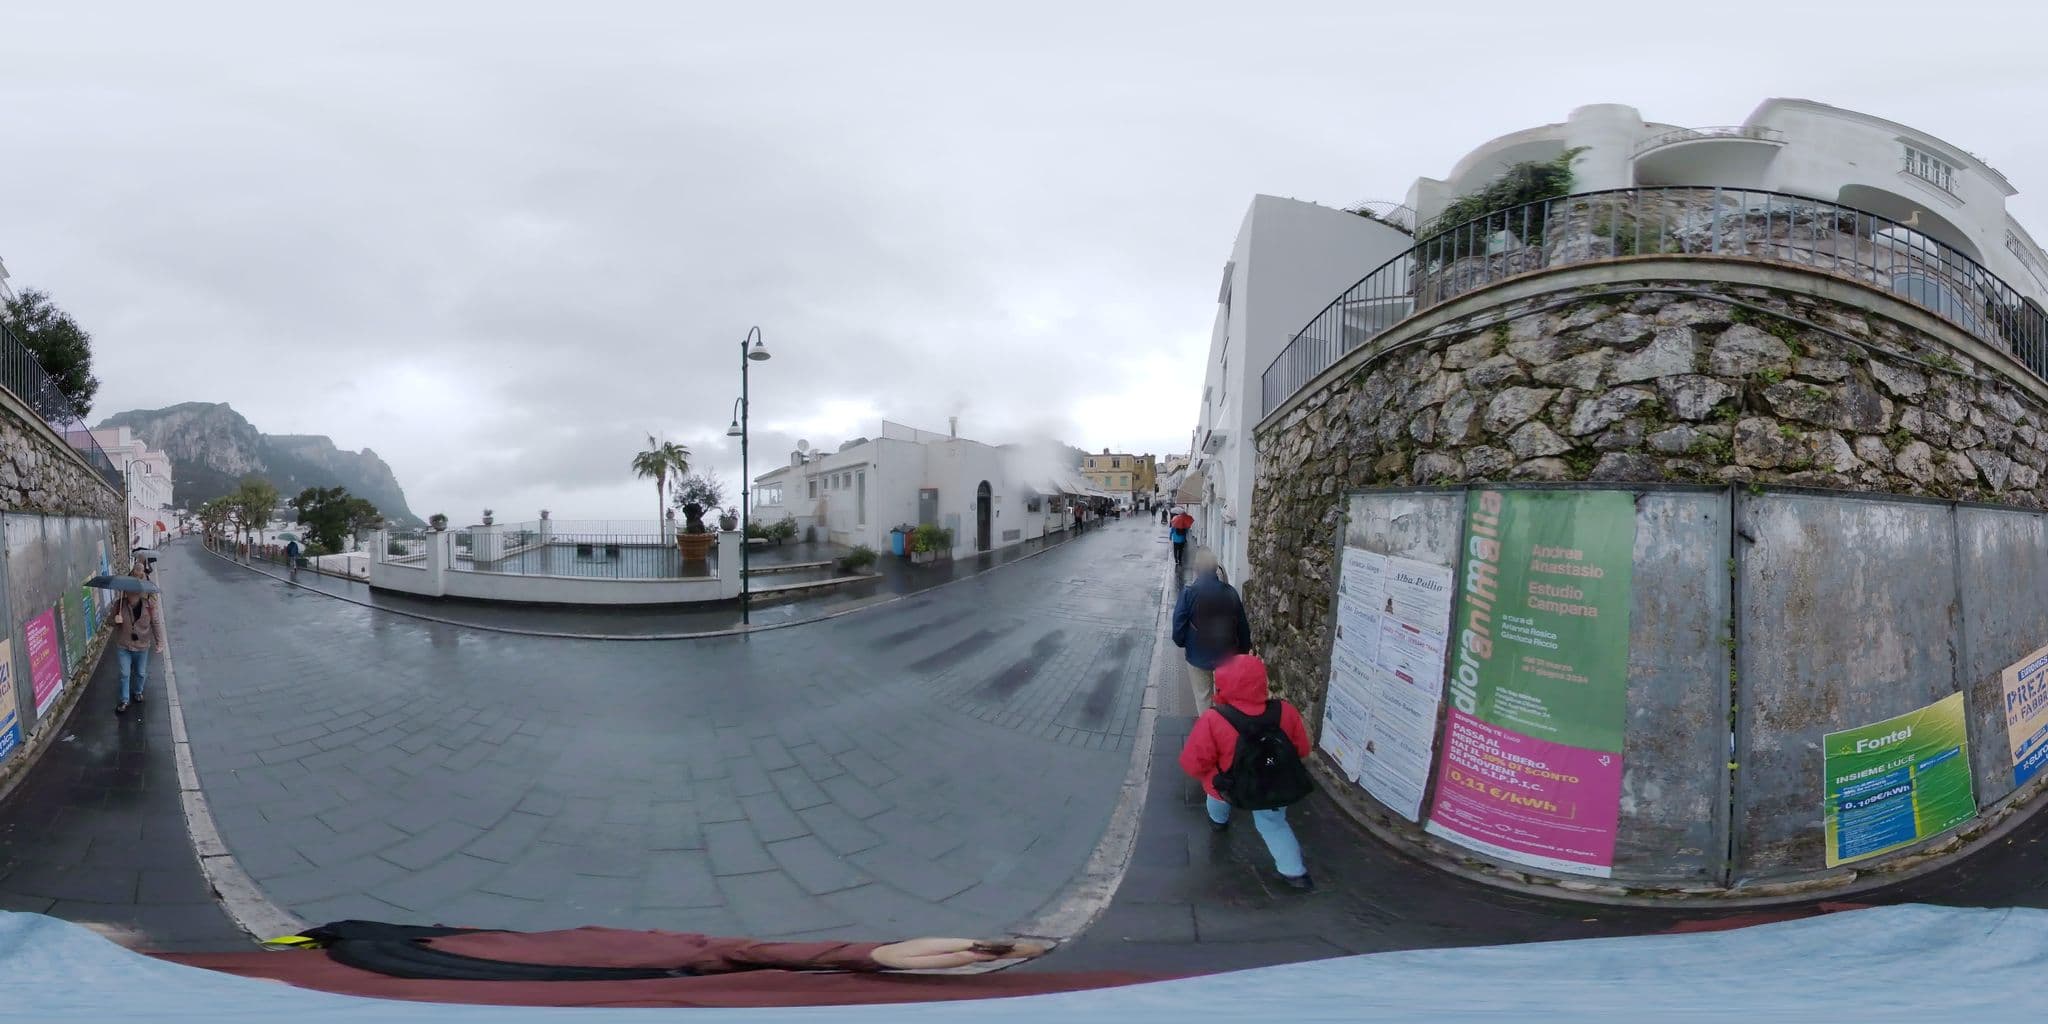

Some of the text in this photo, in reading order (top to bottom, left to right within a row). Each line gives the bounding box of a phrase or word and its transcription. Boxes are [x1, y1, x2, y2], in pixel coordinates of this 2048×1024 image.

[1532, 543, 1583, 561] Andrea
[1530, 559, 1604, 579] Anastasio
[1416, 576, 1443, 592] Pollio
[1528, 581, 1584, 600] Estudio
[1527, 595, 1598, 617] Campana
[1533, 638, 1558, 650] Riccio
[2007, 668, 2048, 713] PREZ
[1453, 722, 1500, 749] PASSA AL
[1856, 725, 1912, 754] Fontel
[1449, 753, 1479, 772] DALLA
[1450, 745, 1517, 778] SE PROVIENI
[1451, 738, 1468, 752] HAI
[1470, 747, 1480, 757] IL
[1508, 762, 1522, 771] DI
[1524, 766, 1579, 784] SCONTO
[1452, 730, 1550, 771] MERCATO LIBERO.
[1836, 765, 1886, 785] INSIEME
[1887, 754, 1916, 770] LUCE
